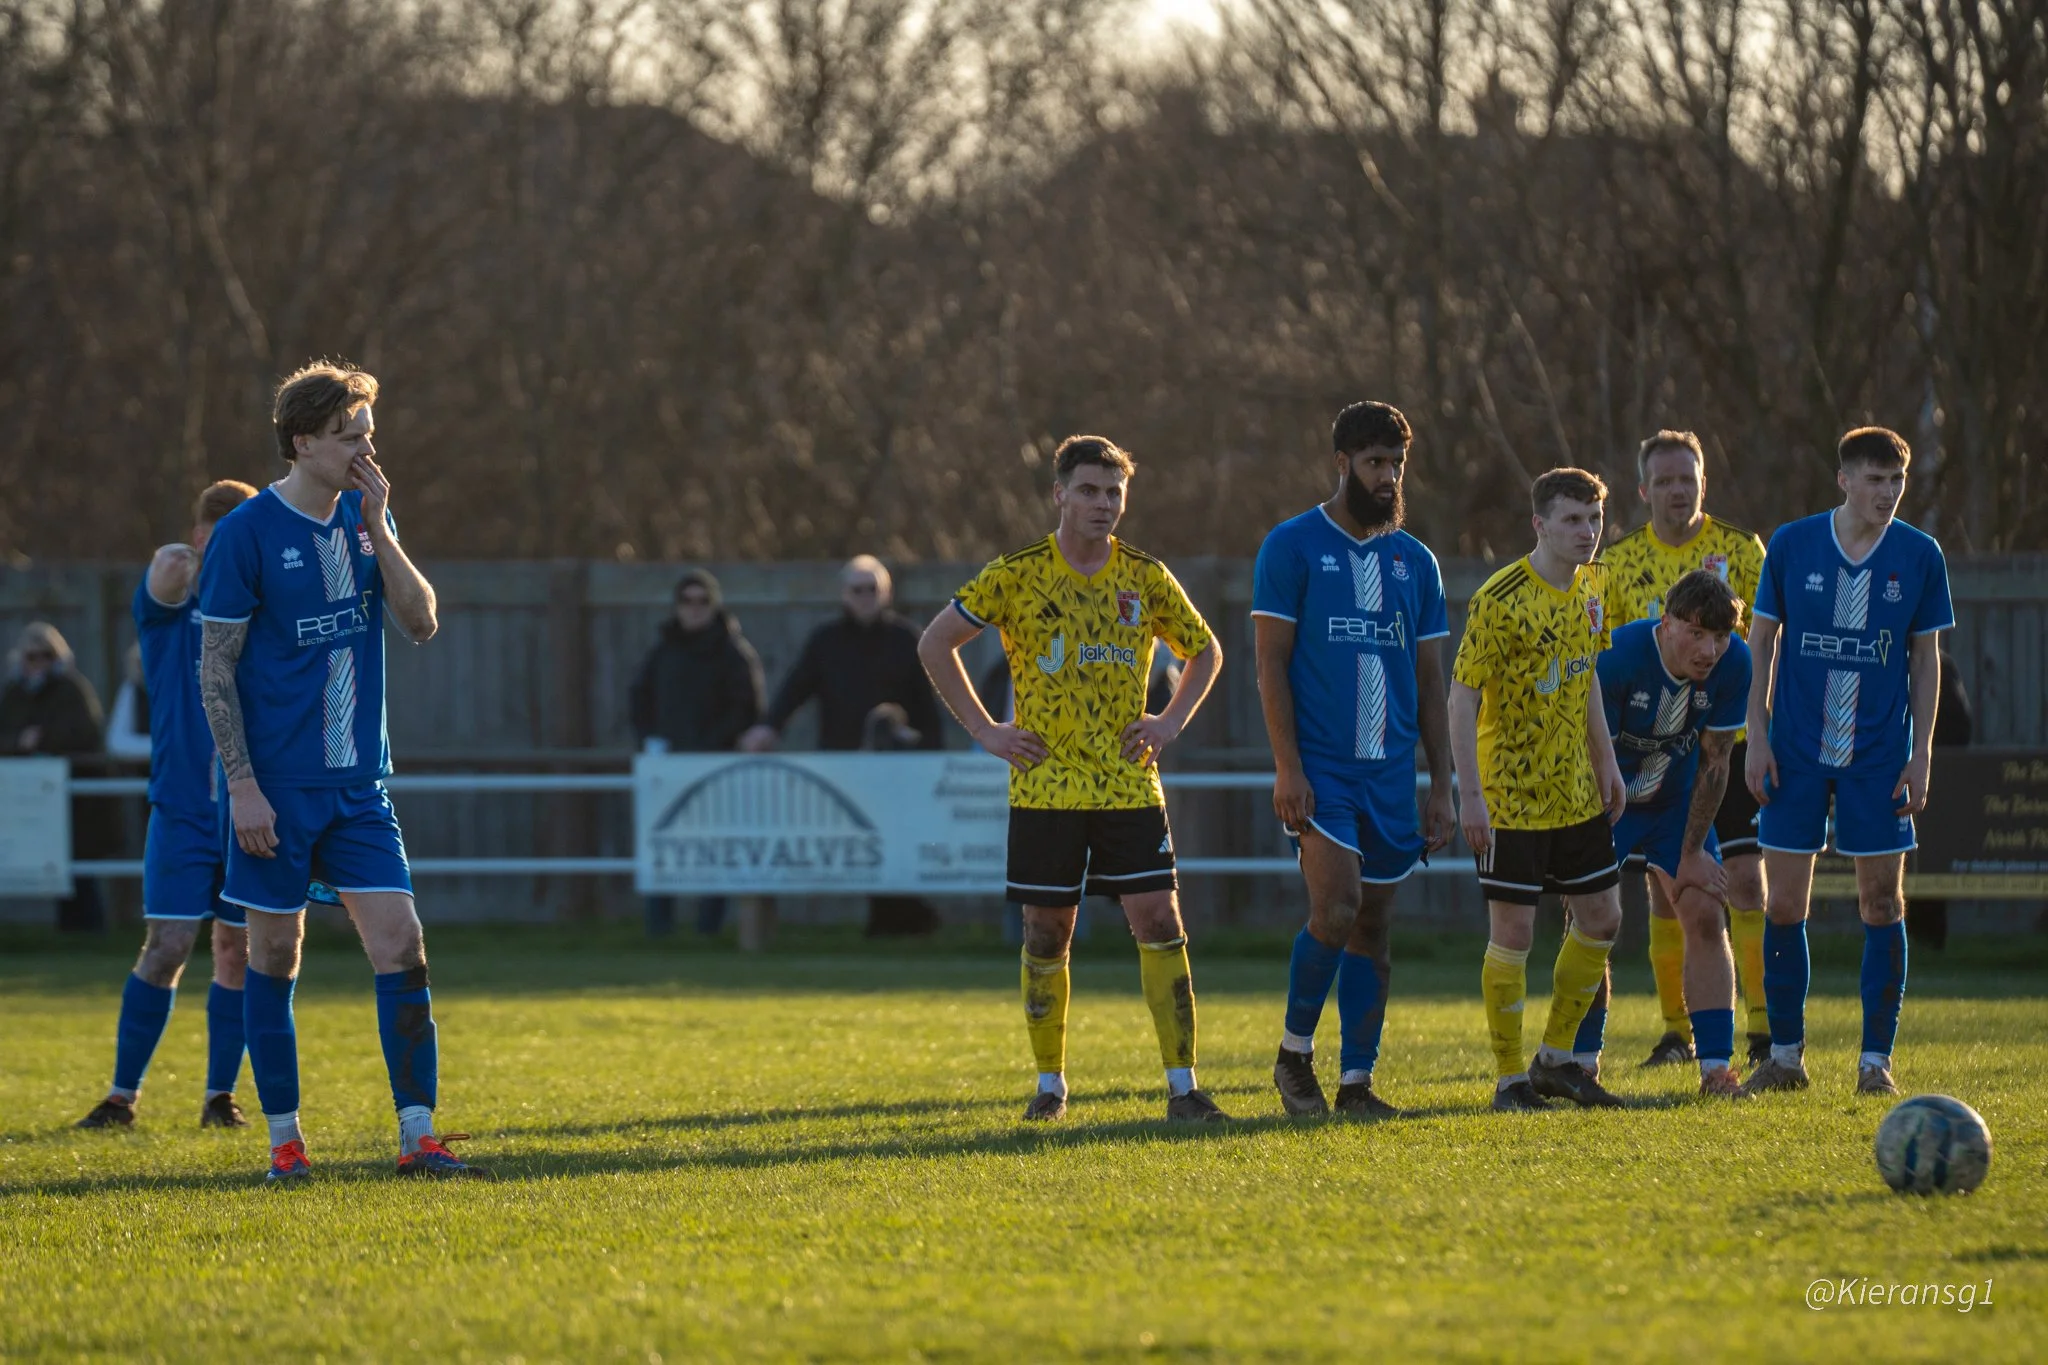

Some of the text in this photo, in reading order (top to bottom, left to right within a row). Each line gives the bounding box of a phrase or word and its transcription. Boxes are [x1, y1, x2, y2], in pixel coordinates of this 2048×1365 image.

[1328, 617, 1394, 639] Park
[1801, 631, 1878, 657] Park
[651, 834, 882, 868] TYNEVALVES
